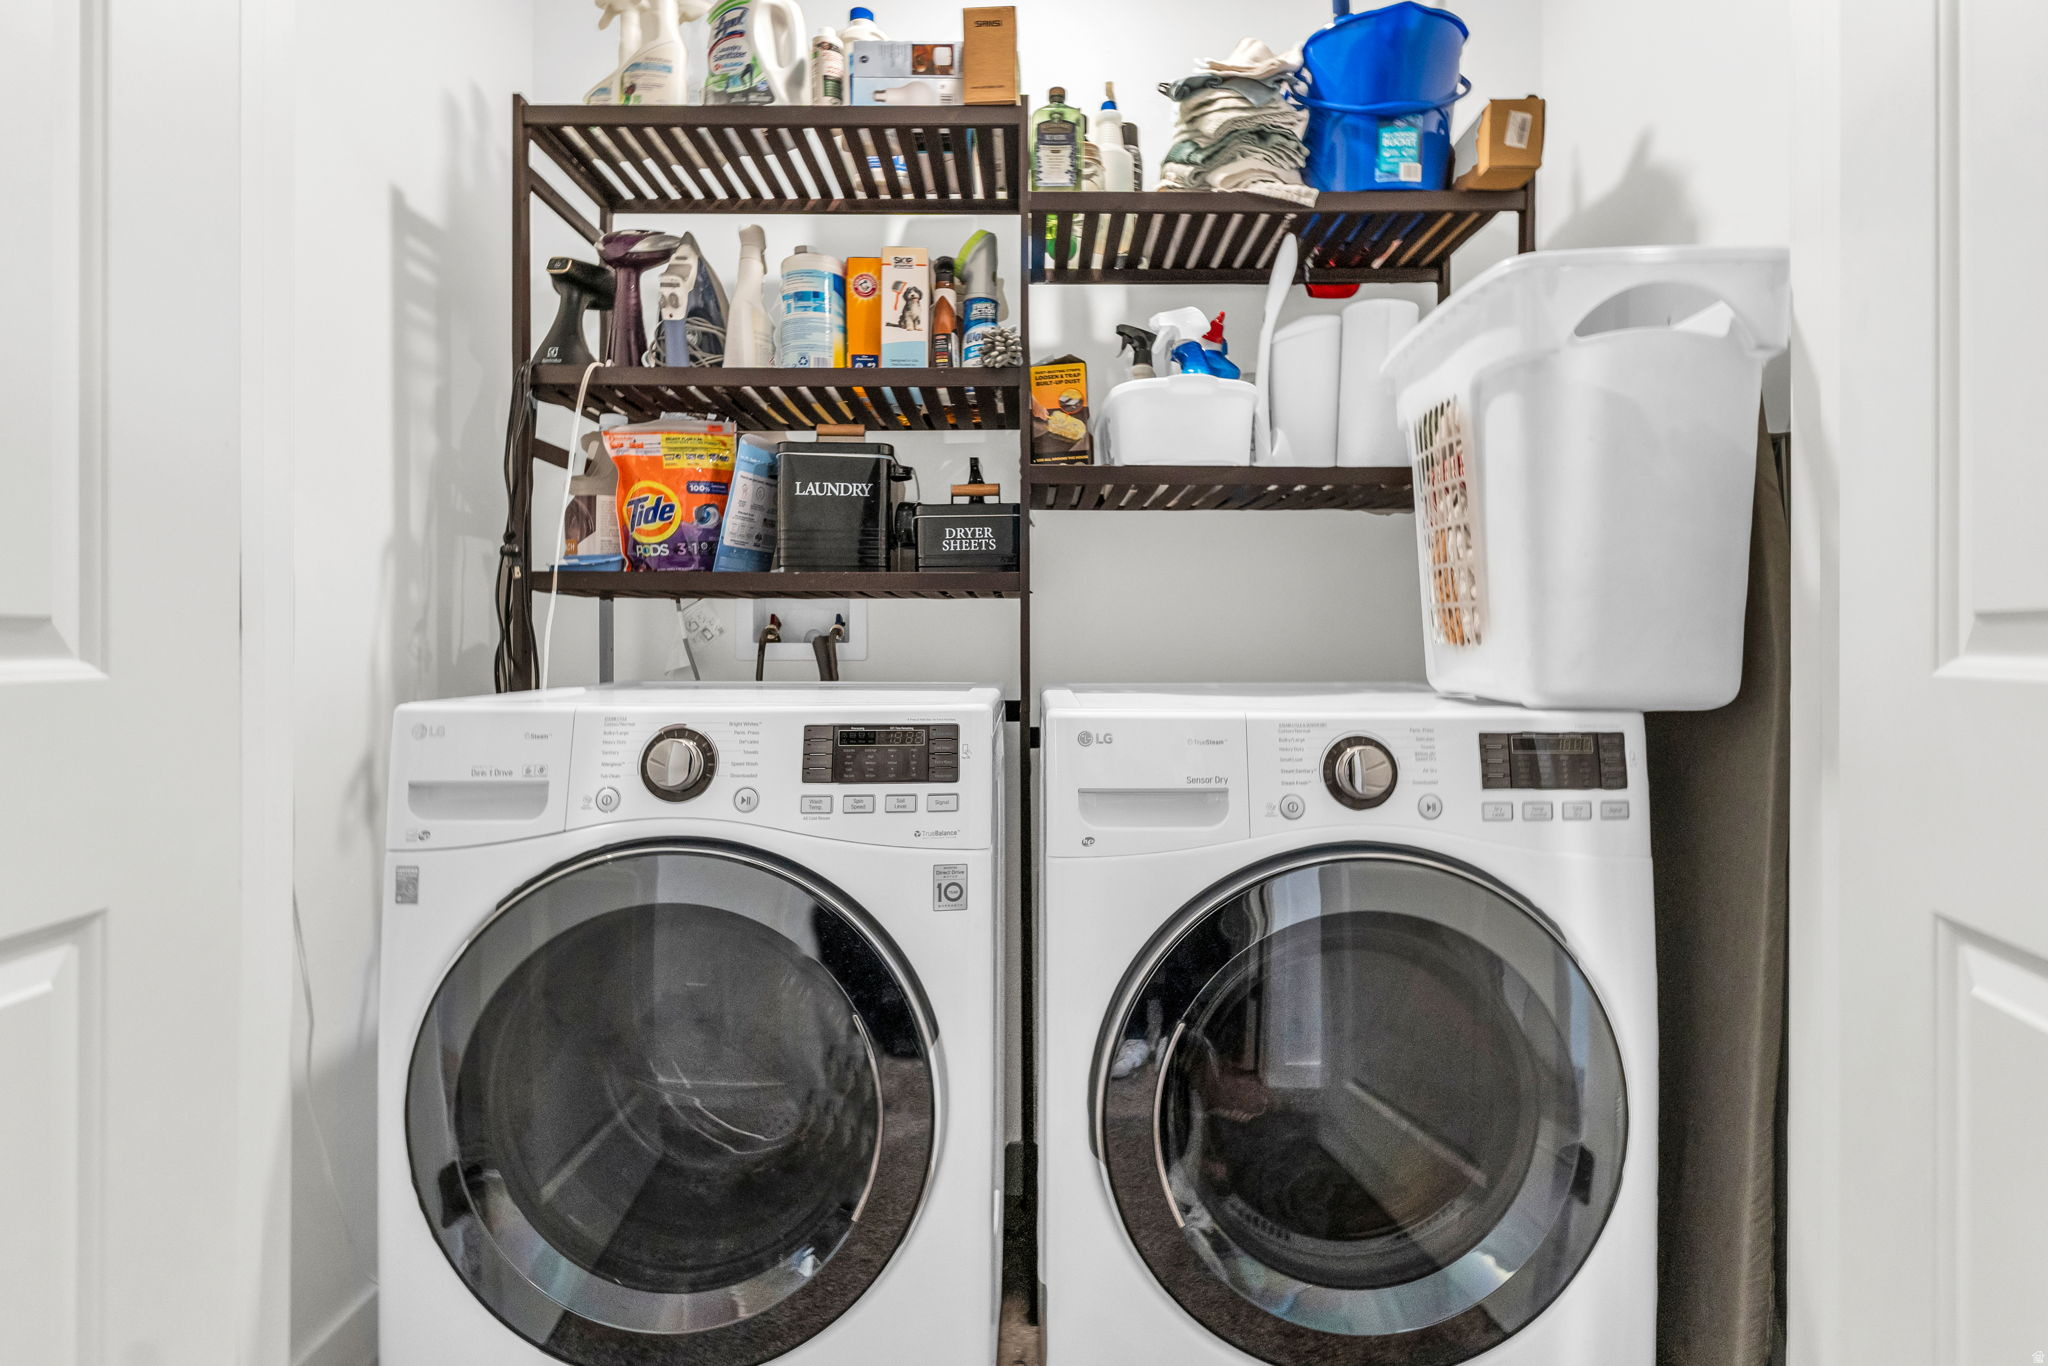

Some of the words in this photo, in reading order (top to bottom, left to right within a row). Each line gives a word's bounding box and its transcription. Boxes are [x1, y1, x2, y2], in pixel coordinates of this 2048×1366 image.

[794, 481, 874, 498] LAUNDRY
[626, 495, 677, 534] Tide
[944, 527, 995, 540] DRYER
[635, 543, 670, 559] PODS
[941, 538, 997, 552] SHEETS
[1095, 732, 1114, 745] LG
[1186, 775, 1213, 785] Sensor
[1214, 775, 1229, 786] Dry
[936, 881, 964, 902] 10
